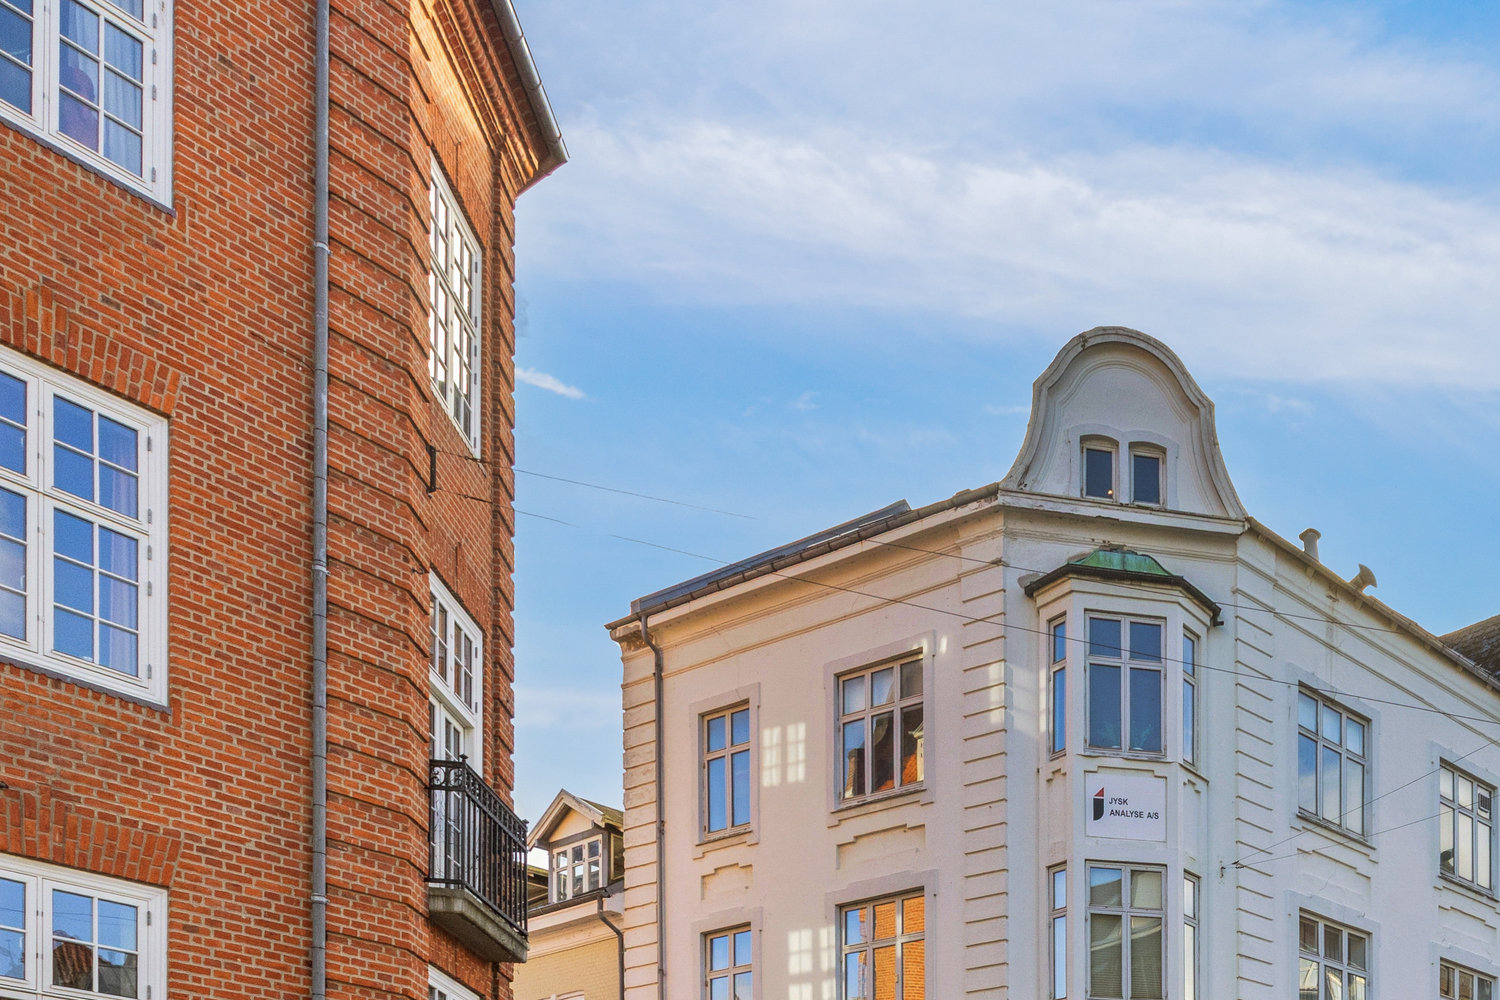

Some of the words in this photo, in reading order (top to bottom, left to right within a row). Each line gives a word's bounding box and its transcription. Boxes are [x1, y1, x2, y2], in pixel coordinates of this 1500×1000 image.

[1108, 797, 1129, 806] JYSK
[1109, 809, 1144, 819] ANALYSE
[1146, 812, 1160, 820] A/S
